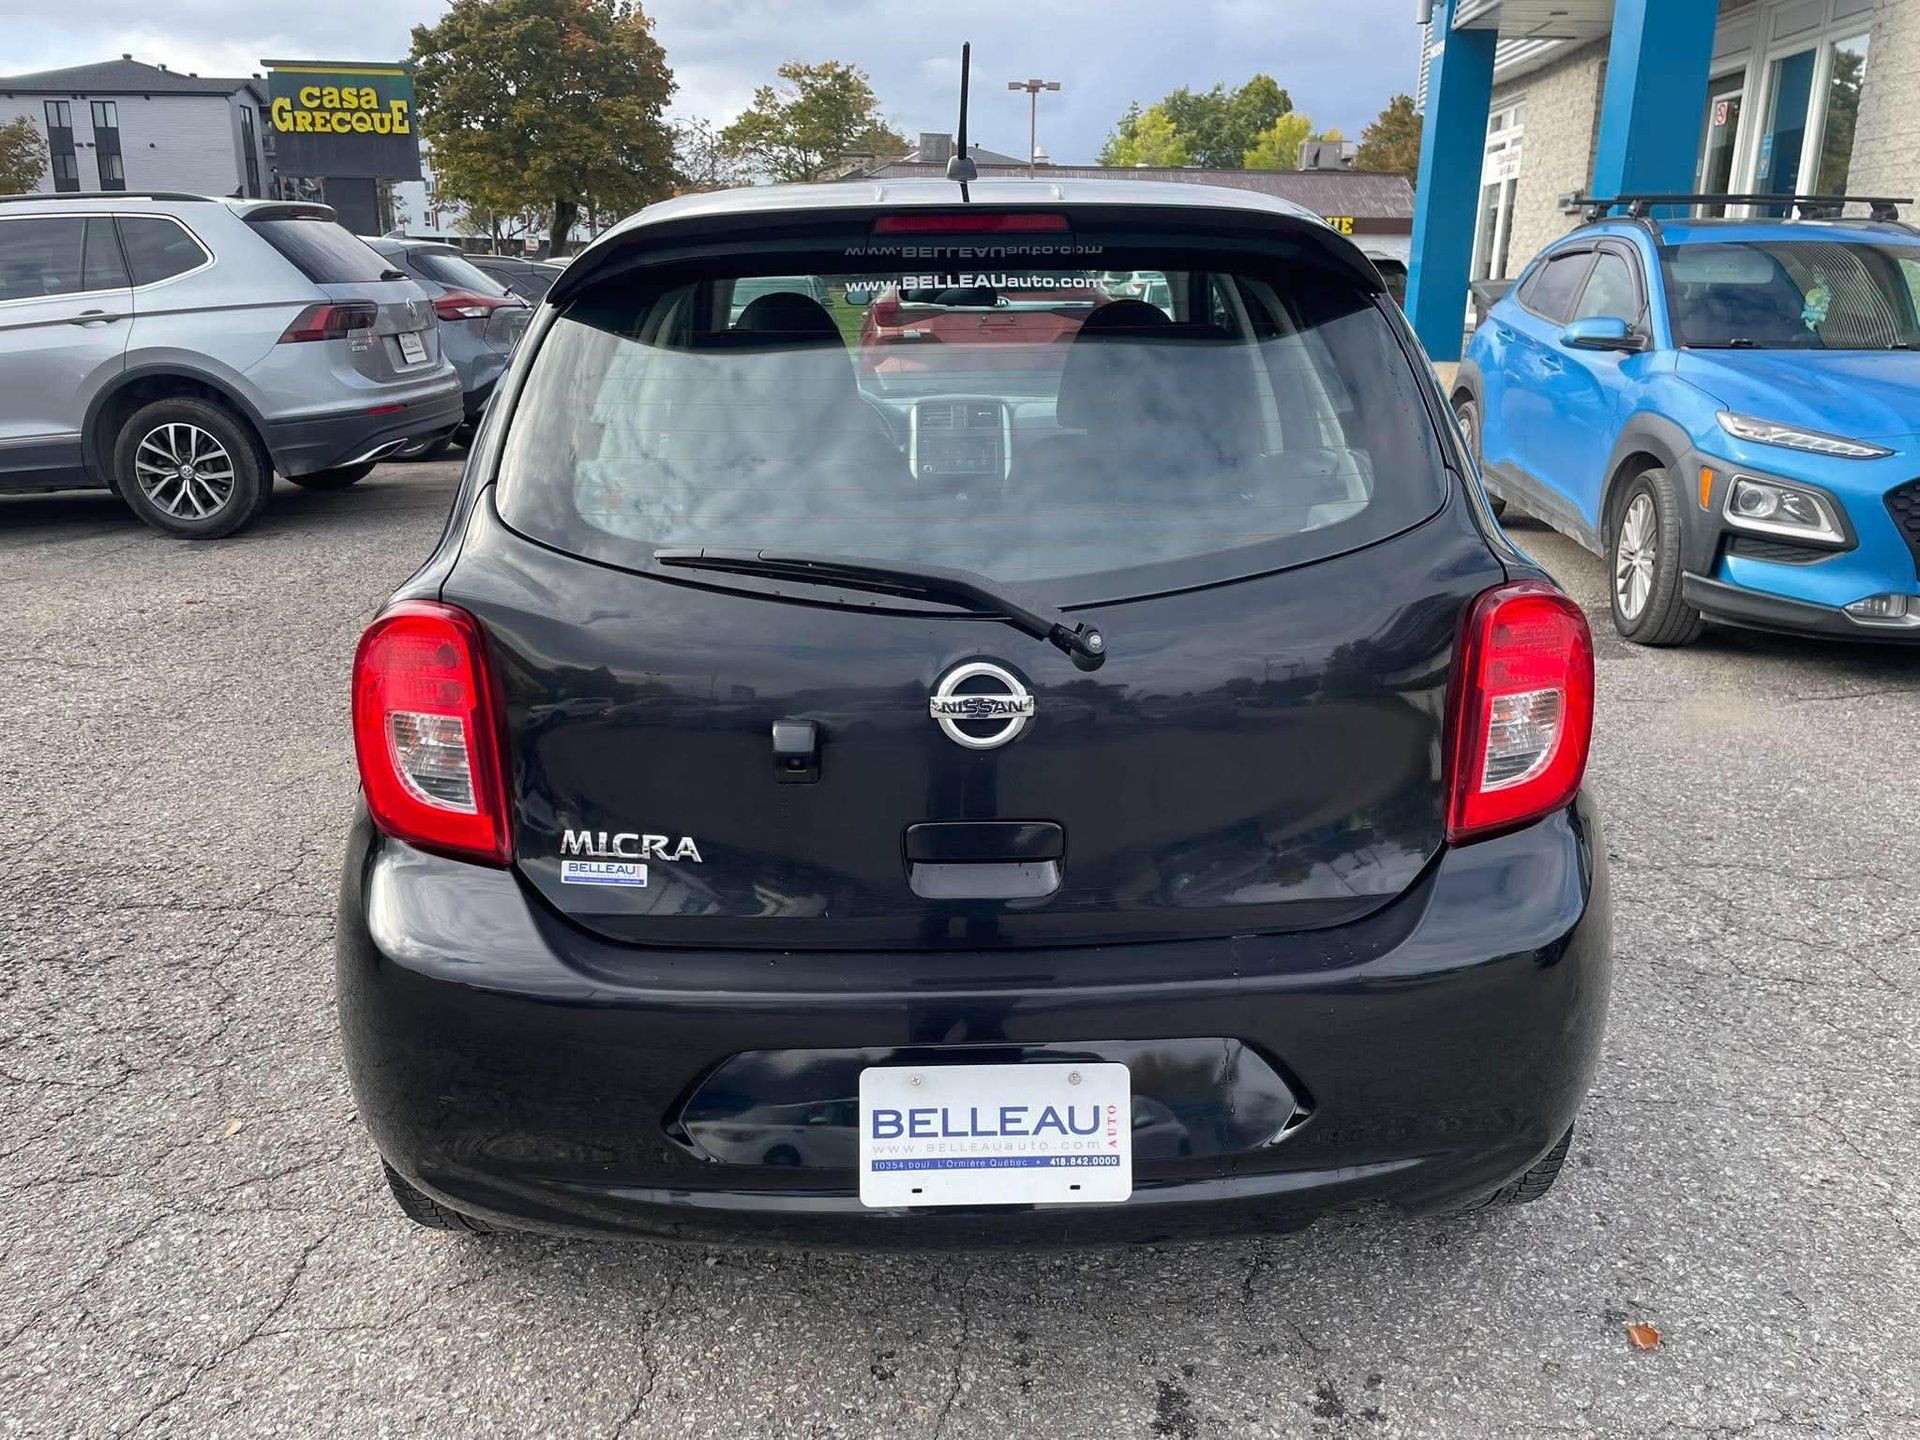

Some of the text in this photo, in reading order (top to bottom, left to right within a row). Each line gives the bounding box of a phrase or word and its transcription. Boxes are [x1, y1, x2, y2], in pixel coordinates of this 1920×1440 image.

[271, 97, 411, 134] GRECQUE
[845, 273, 1104, 292] www.BELLEAUauto.com
[940, 698, 1024, 714] NISSAN
[559, 829, 703, 863] MICRA
[568, 862, 636, 875] BELLEAU
[871, 1105, 1101, 1140] BELLEAU
[1107, 1105, 1118, 1149] AUTO
[1050, 1156, 1118, 1167] 418.842.0000
